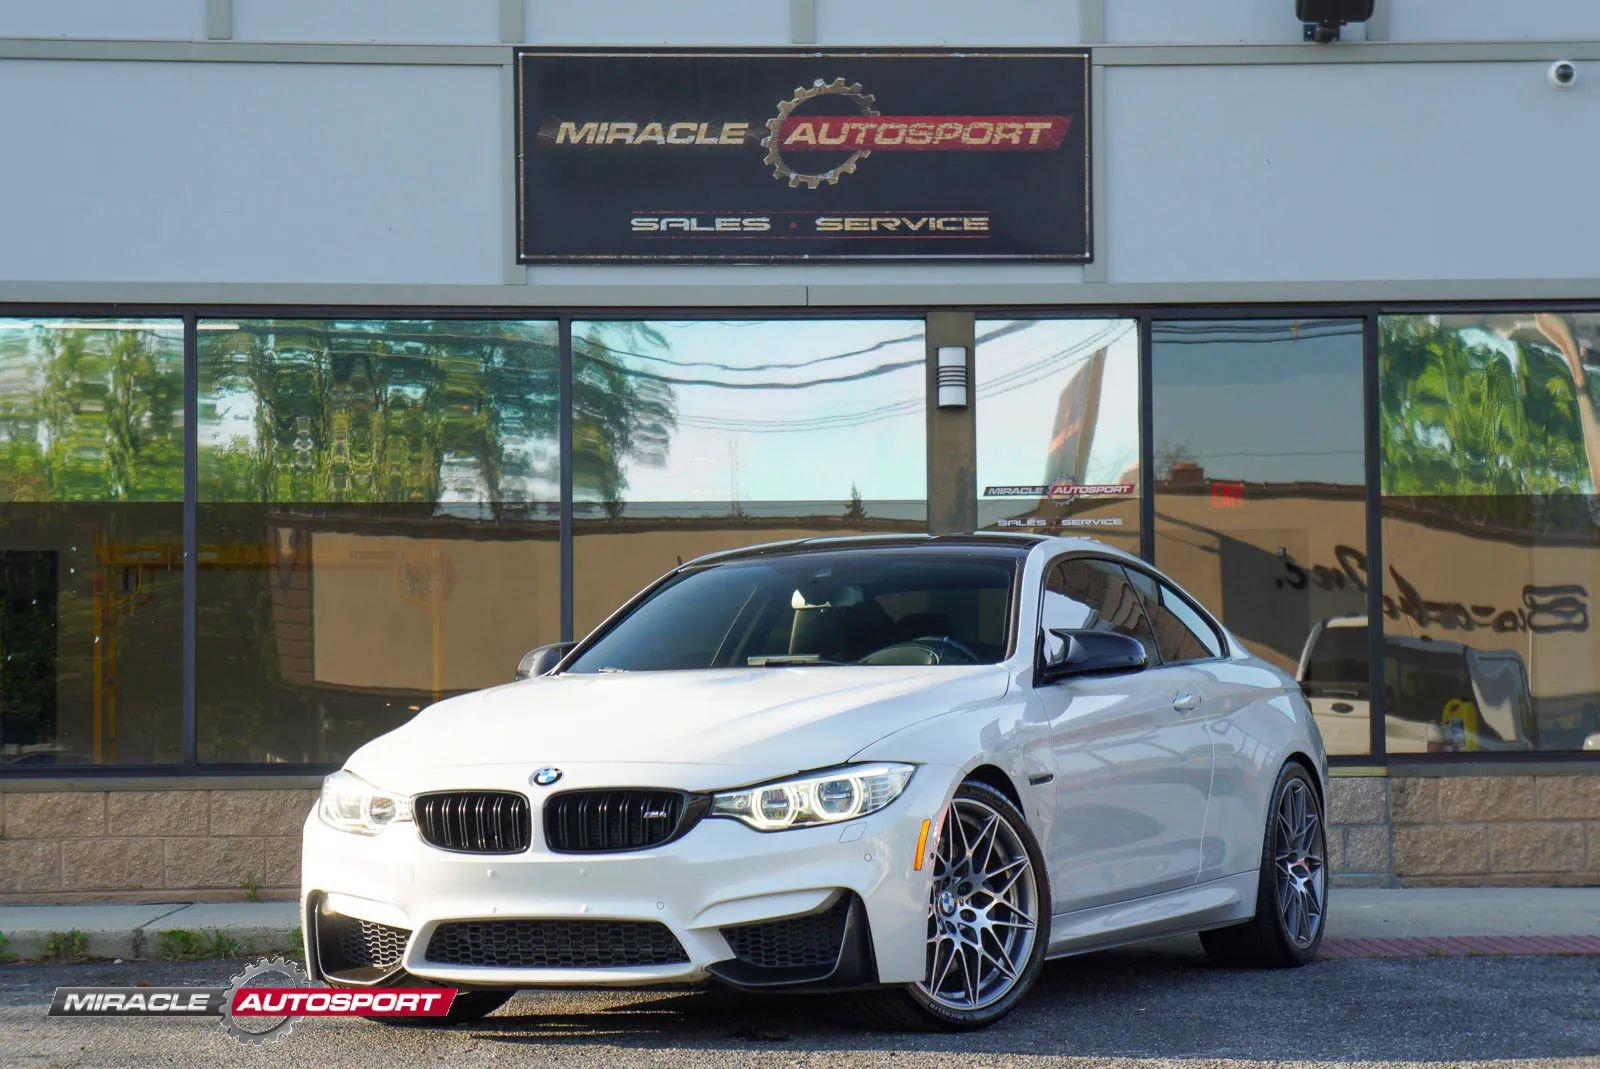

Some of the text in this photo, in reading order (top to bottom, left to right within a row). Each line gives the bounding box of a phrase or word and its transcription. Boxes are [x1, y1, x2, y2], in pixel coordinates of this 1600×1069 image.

[554, 121, 1053, 145] MIRACLE AUTOSPORT
[630, 217, 990, 231] SALES SERVICE
[988, 485, 1131, 495] MIRACLE AUTOSPORT
[998, 518, 1123, 527] SALES SERVICE
